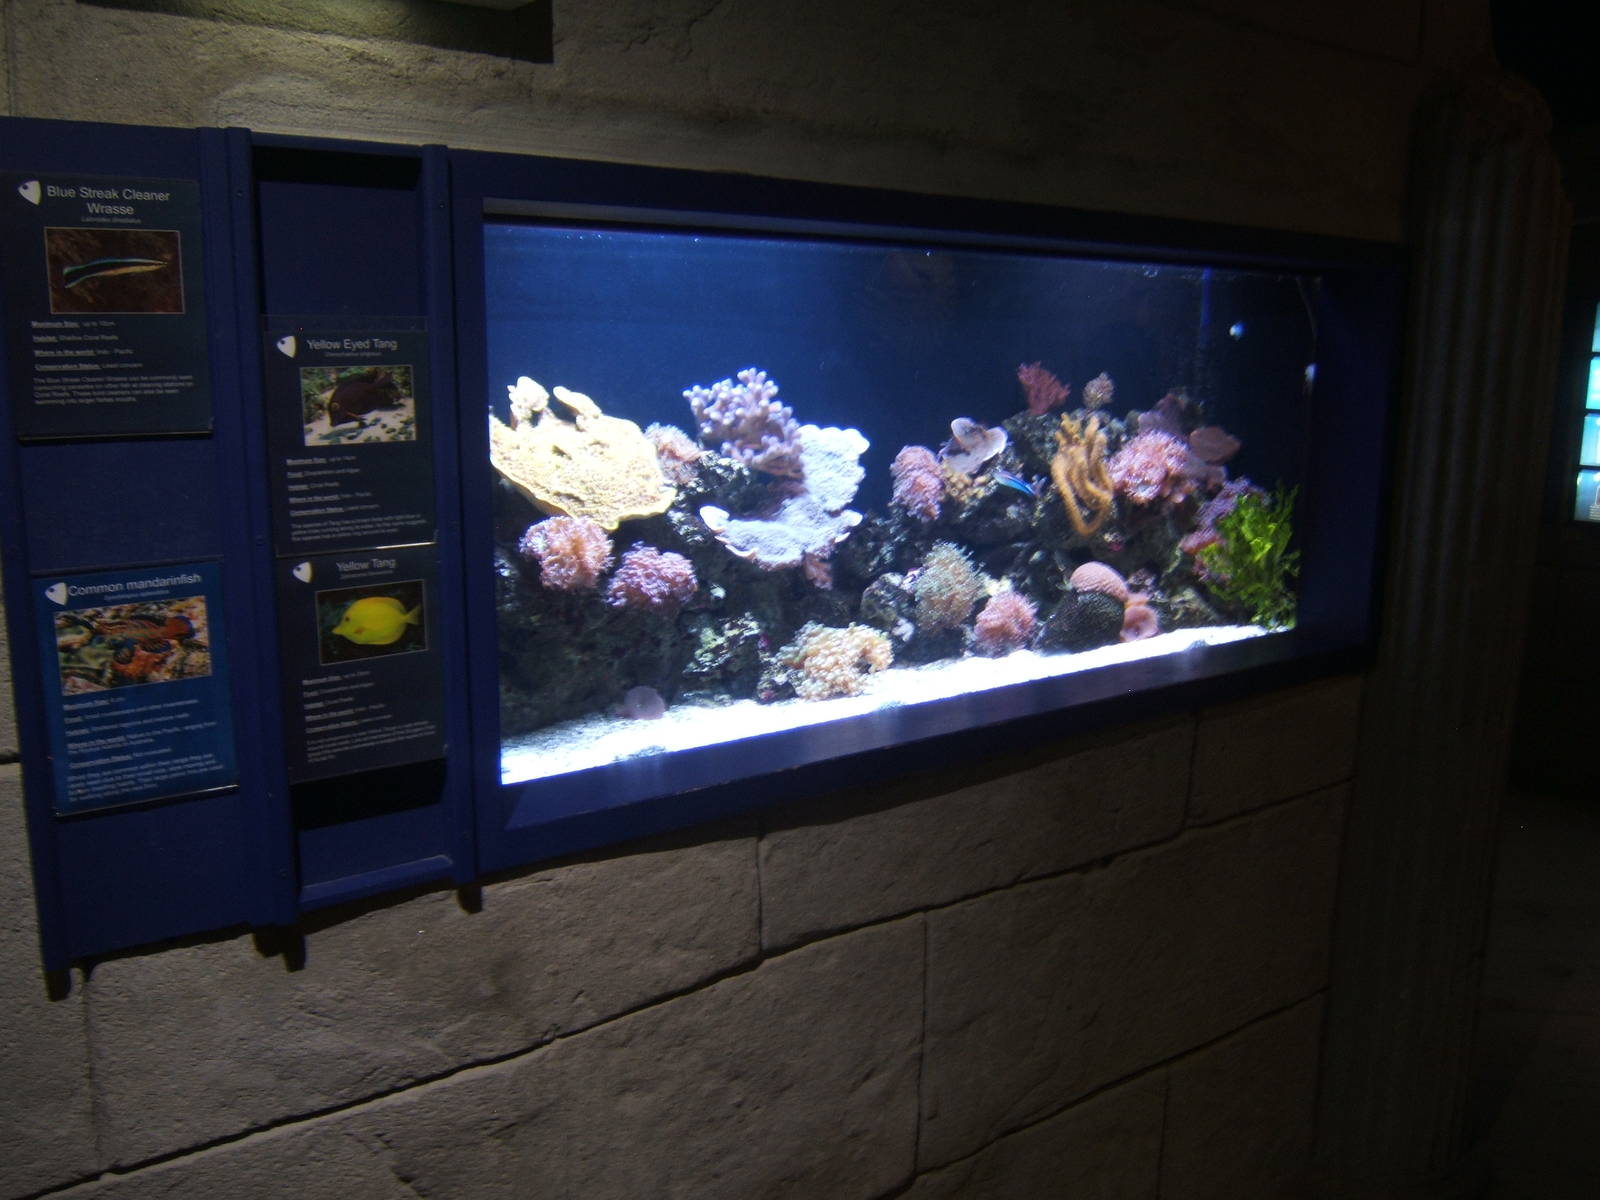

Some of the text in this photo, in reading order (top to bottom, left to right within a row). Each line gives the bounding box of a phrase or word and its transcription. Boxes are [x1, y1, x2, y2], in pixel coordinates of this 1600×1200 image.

[47, 185, 170, 201] Blue Streak Cleaner
[87, 202, 135, 215] Wrasse
[307, 338, 398, 351] Yellow Eyed Tang
[336, 558, 396, 572] Yellow Tang
[68, 581, 124, 597] Common
[126, 573, 202, 591] mandarinfish
